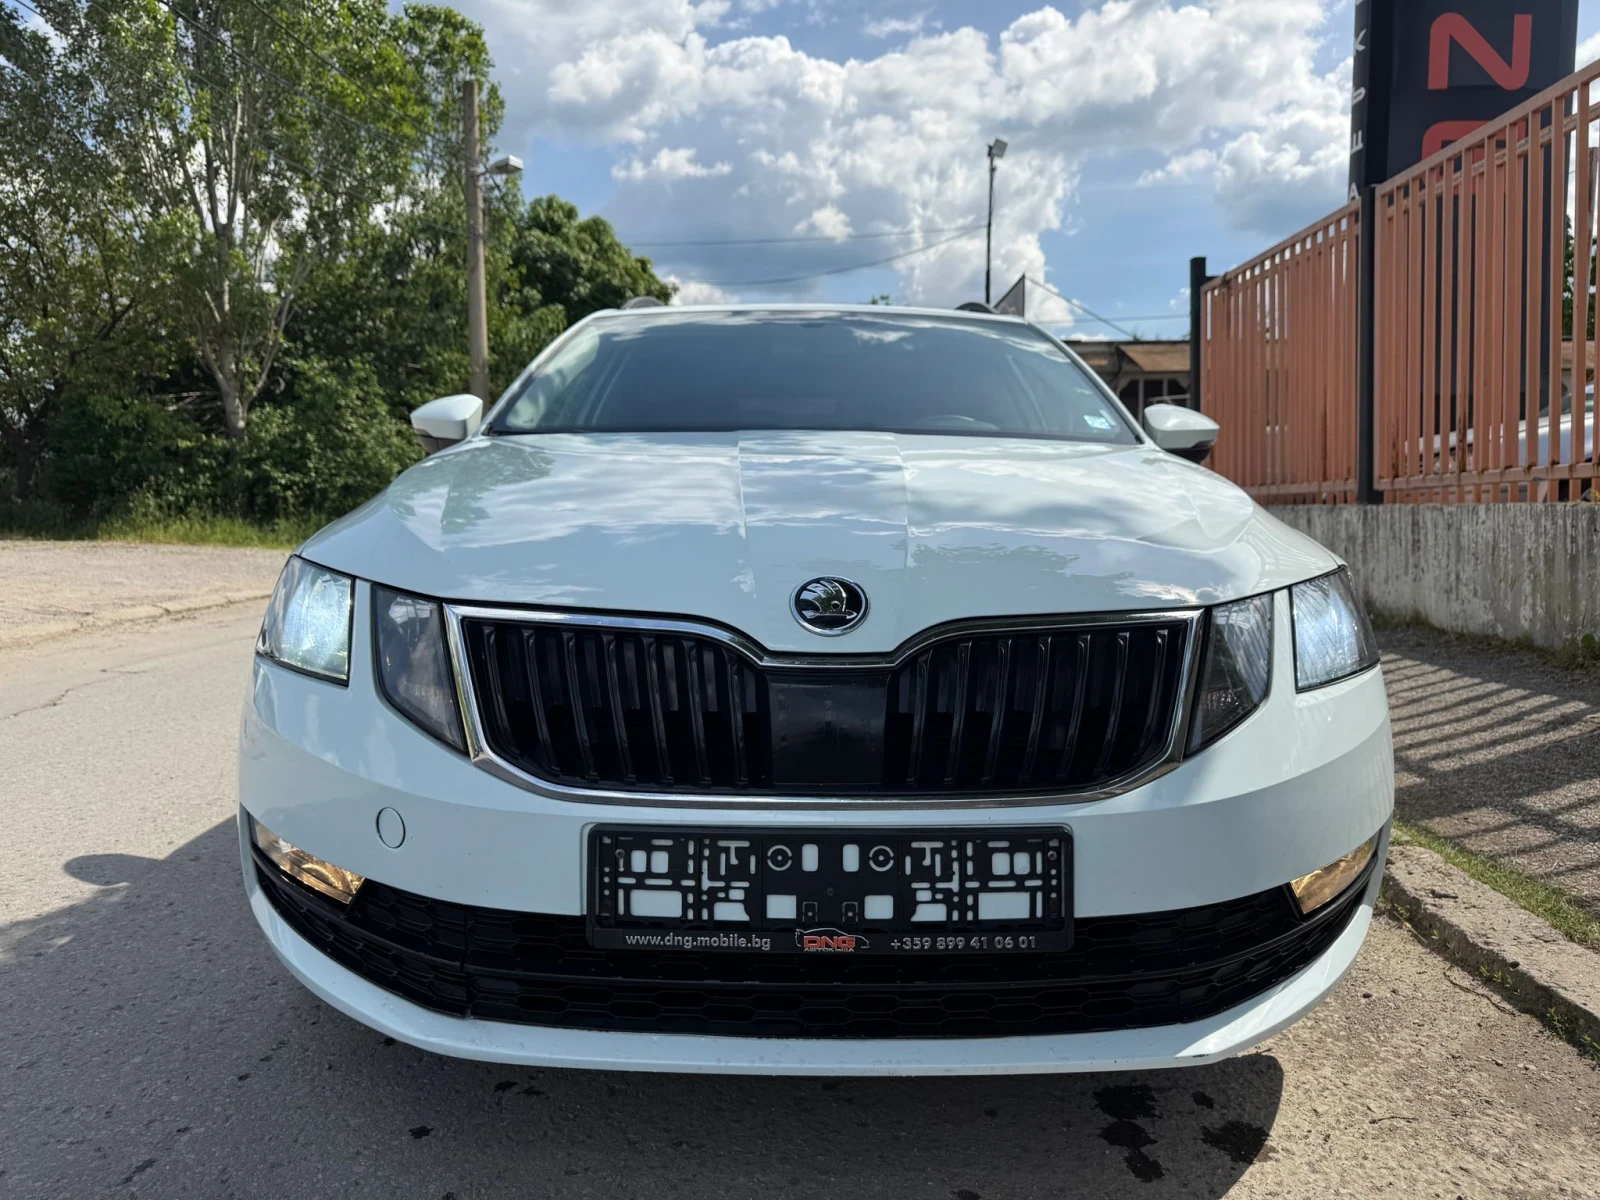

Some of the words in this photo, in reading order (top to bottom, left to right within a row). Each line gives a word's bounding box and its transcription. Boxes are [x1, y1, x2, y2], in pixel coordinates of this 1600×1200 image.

[625, 932, 771, 950] www.dng.mobile.bg
[803, 935, 856, 948] DNG
[890, 937, 932, 949] +359
[936, 937, 966, 949] 899
[970, 937, 988, 949] 41
[994, 936, 1014, 949] 06
[1018, 936, 1036, 948] 01
